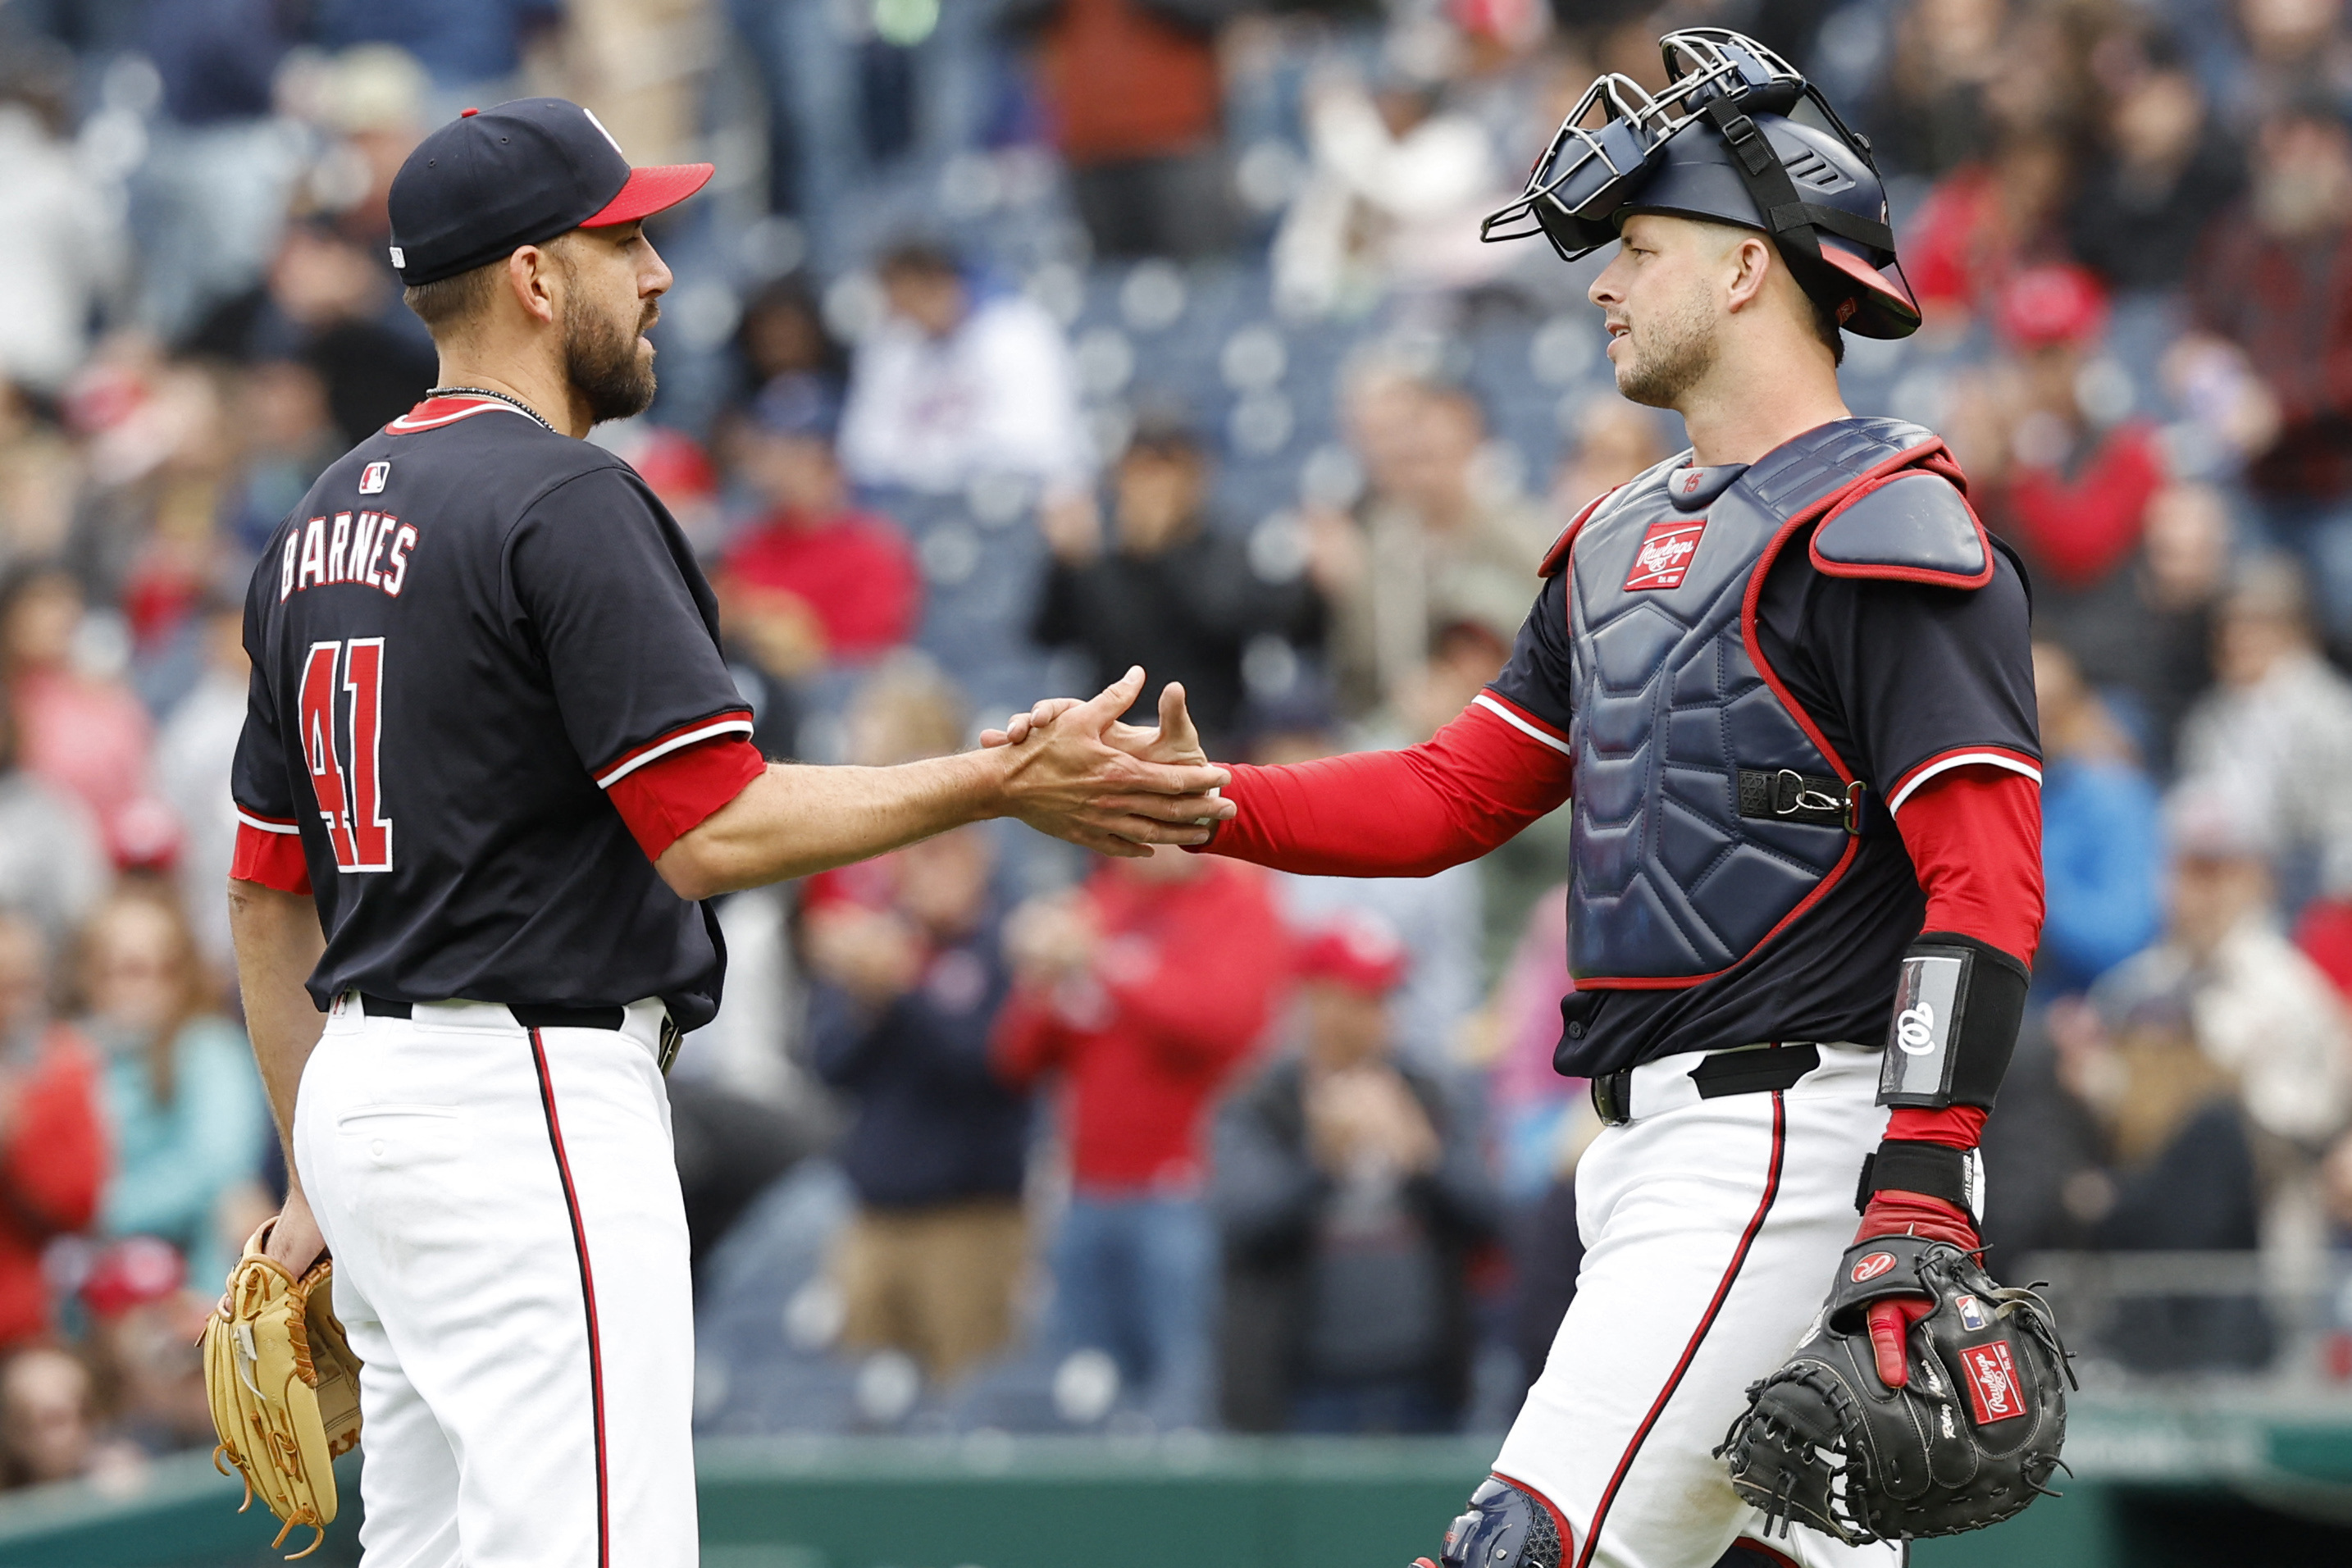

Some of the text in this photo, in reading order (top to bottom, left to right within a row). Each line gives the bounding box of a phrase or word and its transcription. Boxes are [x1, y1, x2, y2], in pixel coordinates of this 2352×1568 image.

[1683, 473, 1703, 494] 15
[280, 510, 418, 604] BARNES
[1636, 536, 1693, 567] Rawlings
[299, 636, 393, 873] 41
[1857, 1254, 1892, 1281] R
[1921, 1359, 1957, 1438] Riley Adams
[1975, 1353, 2008, 1413] Rawlings
